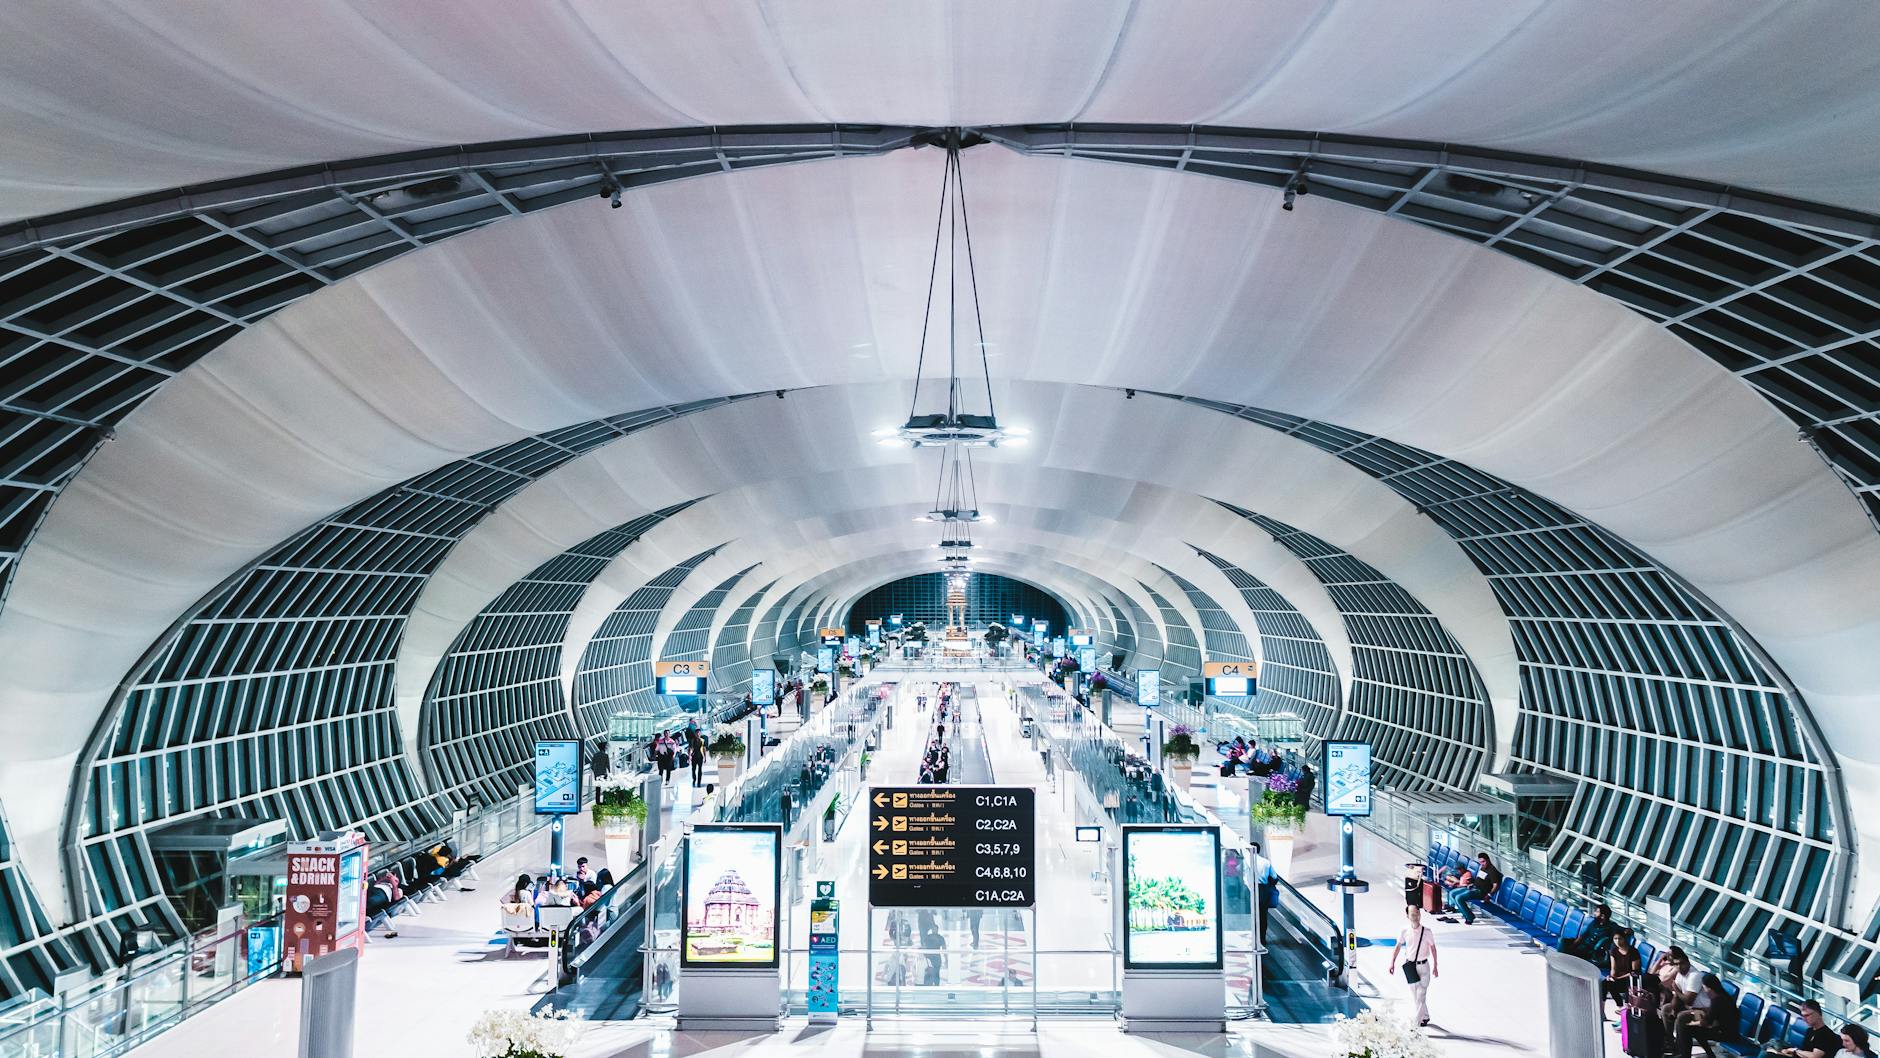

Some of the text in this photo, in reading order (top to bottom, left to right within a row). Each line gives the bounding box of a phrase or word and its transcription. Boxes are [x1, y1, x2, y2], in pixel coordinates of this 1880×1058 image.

[673, 664, 690, 675] C3
[1222, 664, 1239, 676] C4
[975, 795, 1017, 808] C1,C1A
[975, 819, 1017, 831] C2,C2A
[975, 843, 1020, 855] C3,5,7,9
[291, 857, 336, 872] SNACK
[290, 873, 335, 885] &DRINK
[975, 867, 1027, 879] C4,6,8,10
[975, 890, 1025, 902] C1A,C2A
